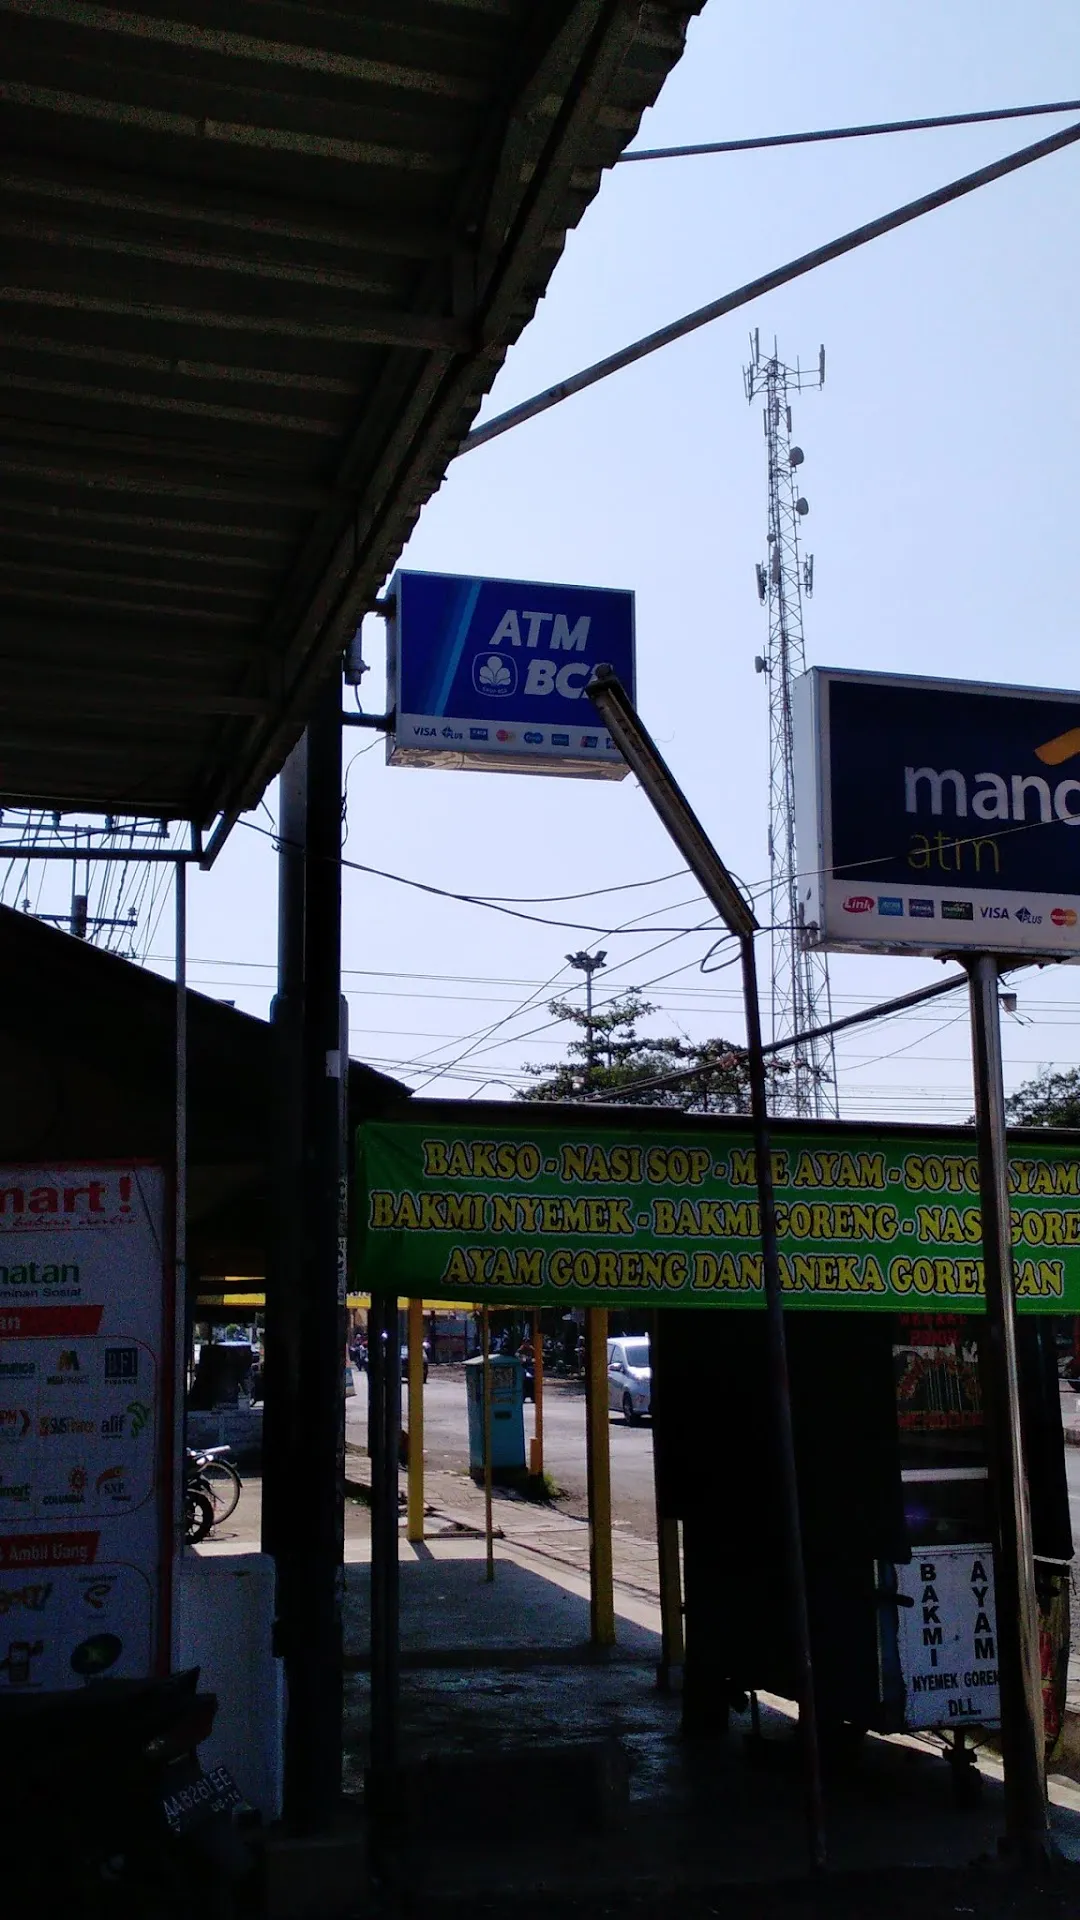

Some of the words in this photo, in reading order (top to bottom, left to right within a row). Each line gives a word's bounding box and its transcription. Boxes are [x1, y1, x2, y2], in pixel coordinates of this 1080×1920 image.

[489, 609, 592, 651] ATM
[413, 727, 437, 737] VISA
[907, 831, 1000, 873] atm
[843, 899, 873, 912] Link
[980, 906, 1009, 920] VISA
[423, 1140, 541, 1181] BAKSO
[560, 1145, 643, 1183] NASI
[647, 1148, 710, 1186] SOP
[729, 1150, 789, 1188] ME
[793, 1152, 886, 1190] AYAM
[904, 1155, 980, 1192] SOTO
[370, 1191, 486, 1229] BAKMI
[491, 1195, 635, 1234] NYEMEK
[652, 1199, 763, 1239] BAKMI
[442, 1247, 545, 1286] AYAM
[549, 1250, 689, 1290] GORENG
[692, 1253, 765, 1291] DAN
[107, 1351, 136, 1374] BFI
[101, 1415, 124, 1433] alif
[9, 1545, 48, 1561] Ambil
[52, 1543, 88, 1562] Uang
[920, 1563, 944, 1667] BAKMI
[970, 1560, 995, 1660] AYAM
[912, 1671, 958, 1692] NYEMEK
